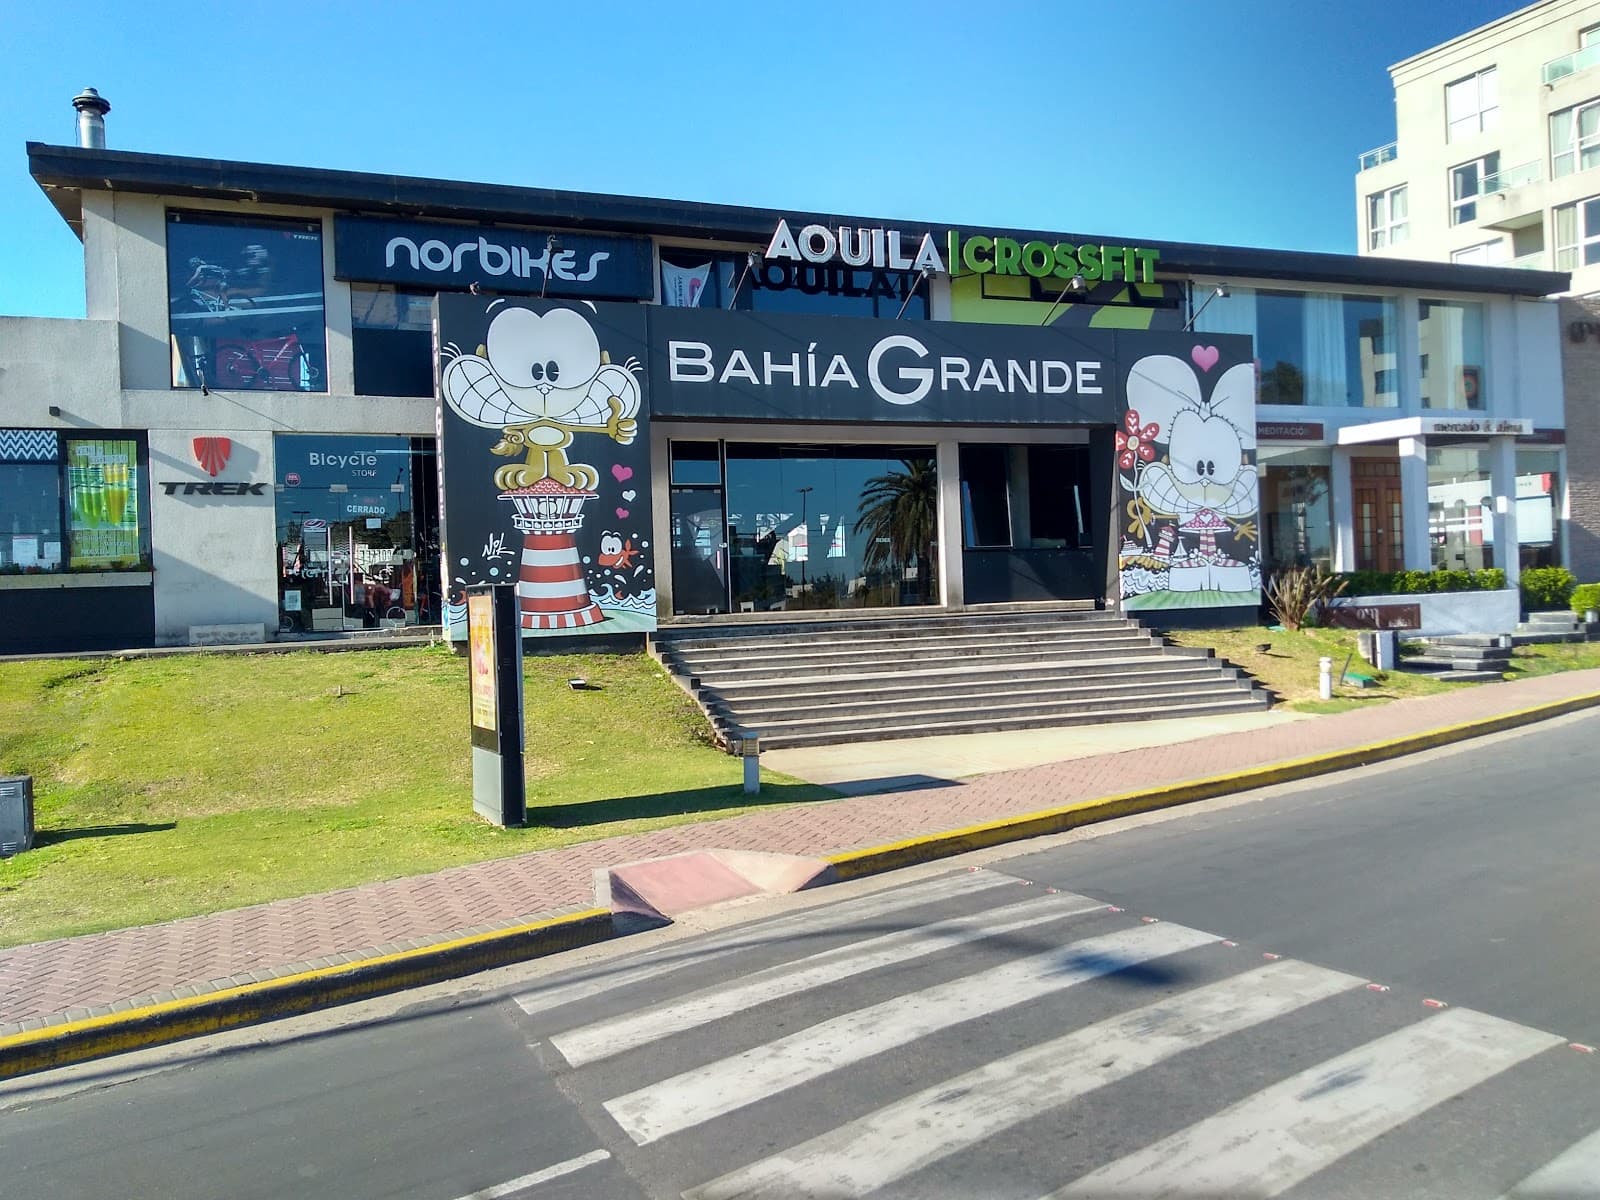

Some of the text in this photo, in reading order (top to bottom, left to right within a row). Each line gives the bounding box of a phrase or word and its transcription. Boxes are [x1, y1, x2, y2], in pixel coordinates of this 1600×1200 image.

[963, 235, 1160, 284] CROSSFIT
[867, 334, 1103, 406] GRANDE
[309, 452, 377, 469] Bicycle
[159, 481, 268, 496] TREK
[346, 504, 386, 515] CERRADO
